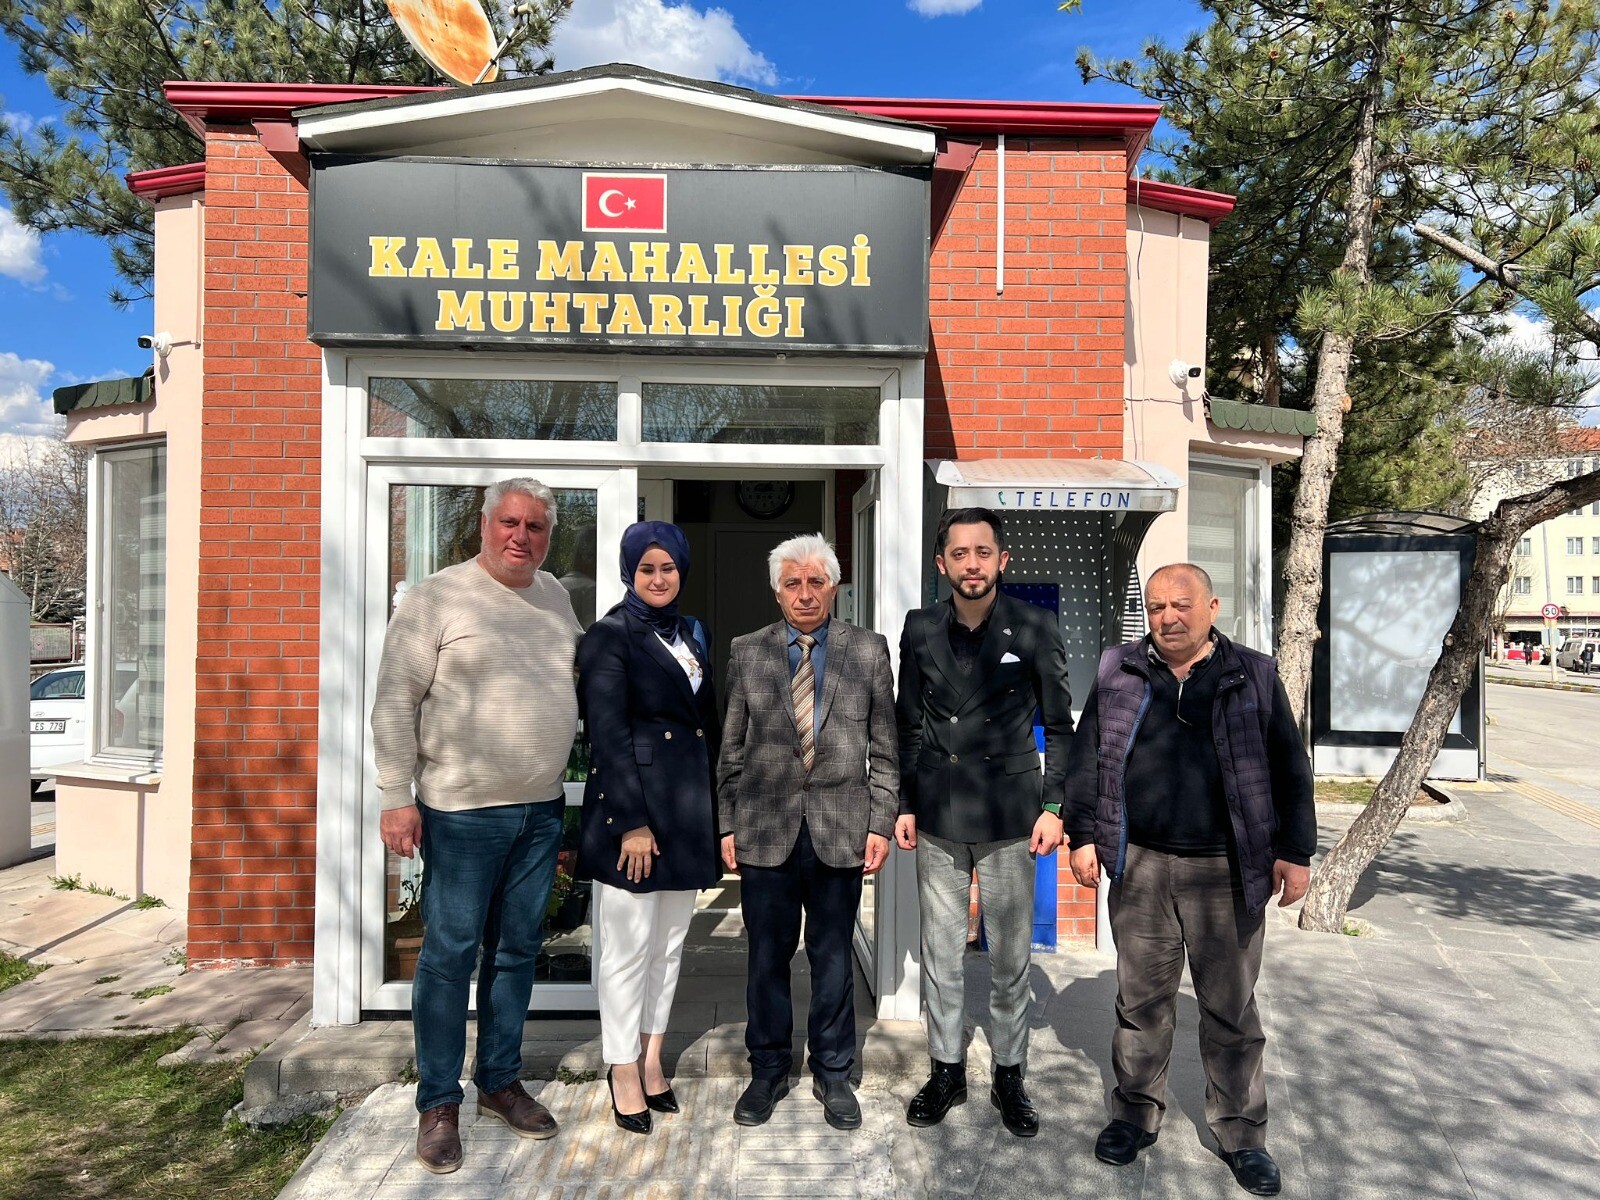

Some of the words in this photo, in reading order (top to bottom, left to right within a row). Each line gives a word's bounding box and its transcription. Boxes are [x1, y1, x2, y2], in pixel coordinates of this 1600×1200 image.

[368, 236, 520, 280] KALE
[536, 233, 872, 287] MAHALLESİ
[435, 284, 805, 338] MUHTARLIĞI
[1016, 492, 1130, 508] TELEFON
[1545, 607, 1557, 615] 50
[35, 722, 44, 730] ES
[49, 722, 63, 730] 779
